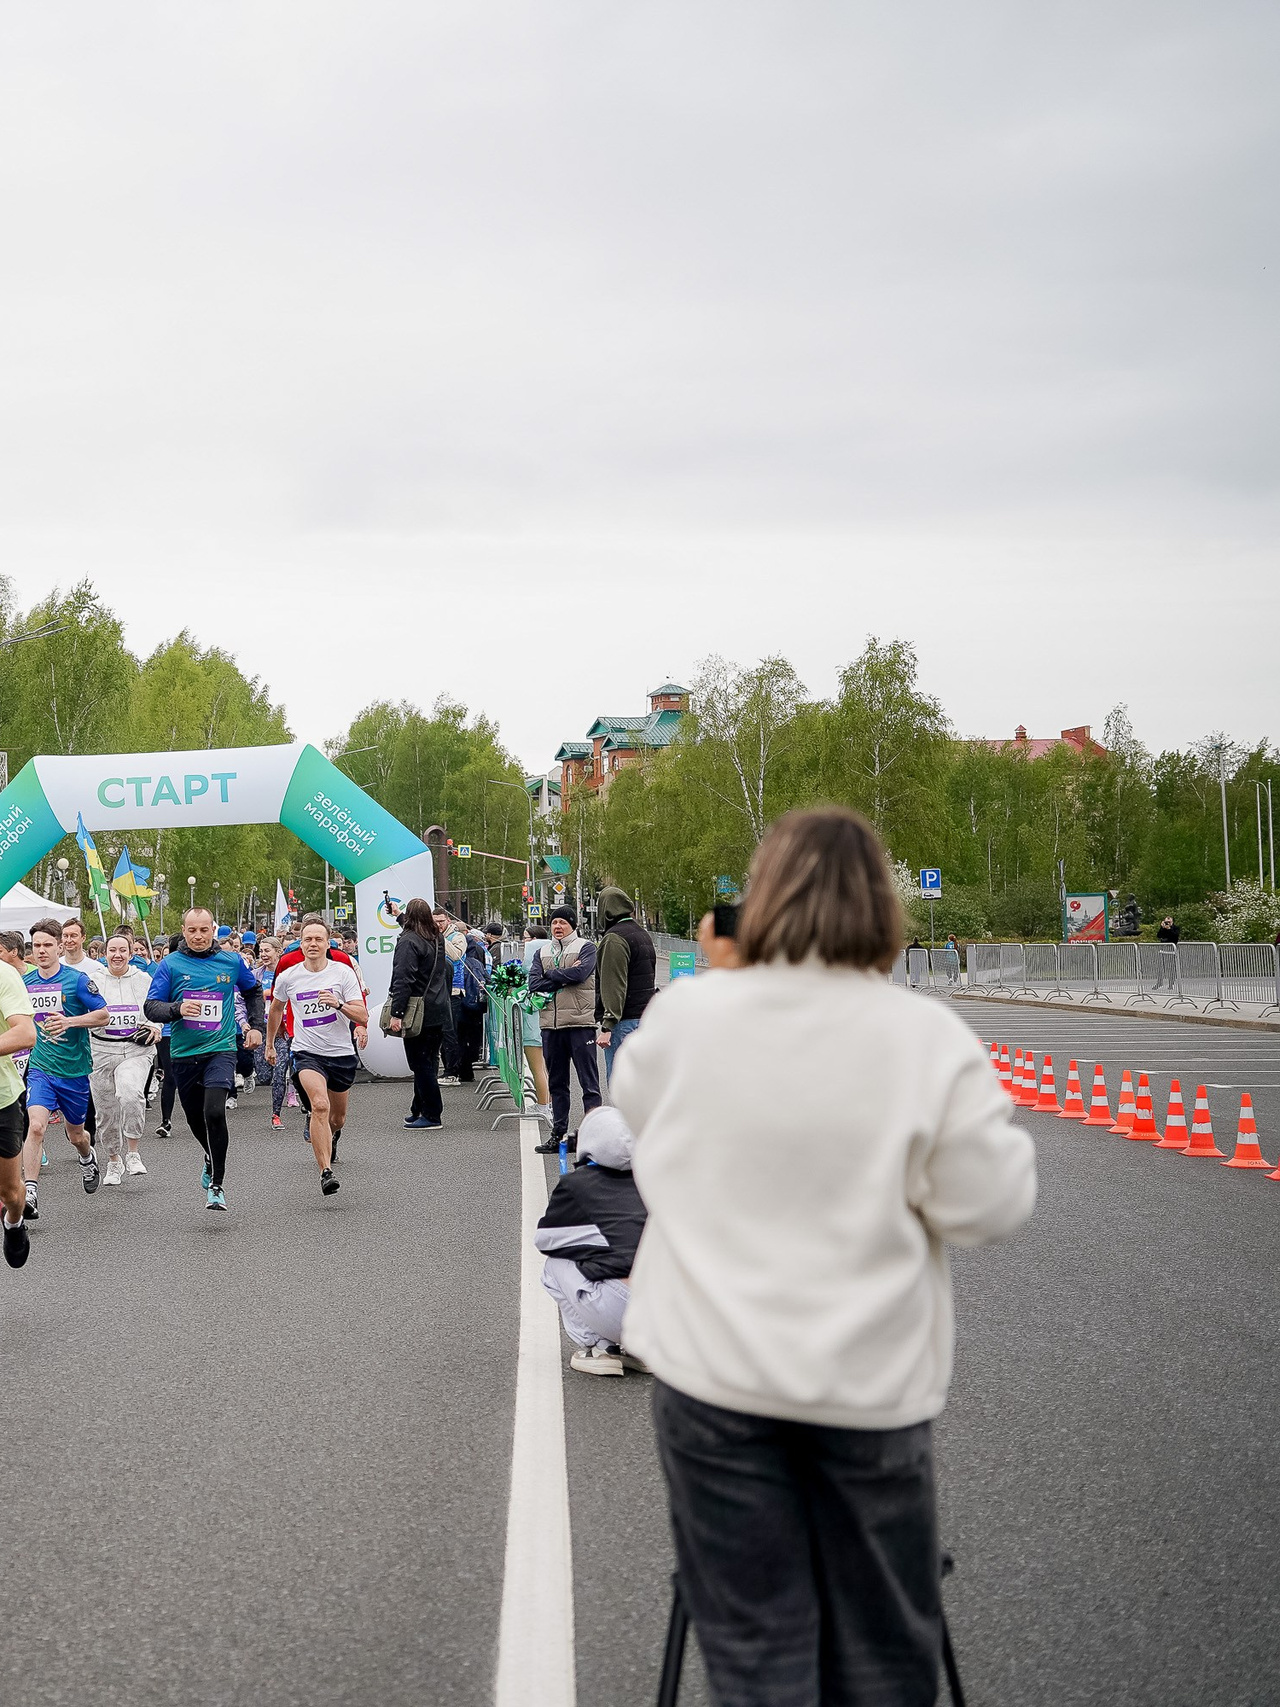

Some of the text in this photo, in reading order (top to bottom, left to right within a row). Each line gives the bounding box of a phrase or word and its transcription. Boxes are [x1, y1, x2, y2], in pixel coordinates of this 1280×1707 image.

[97, 772, 237, 808] СТАРТ
[313, 791, 377, 846] зелёный
[303, 802, 365, 857] марафон
[926, 871, 938, 887] P
[365, 935, 396, 955] СБ
[32, 996, 57, 1008] 2059
[110, 1015, 136, 1025] 2153
